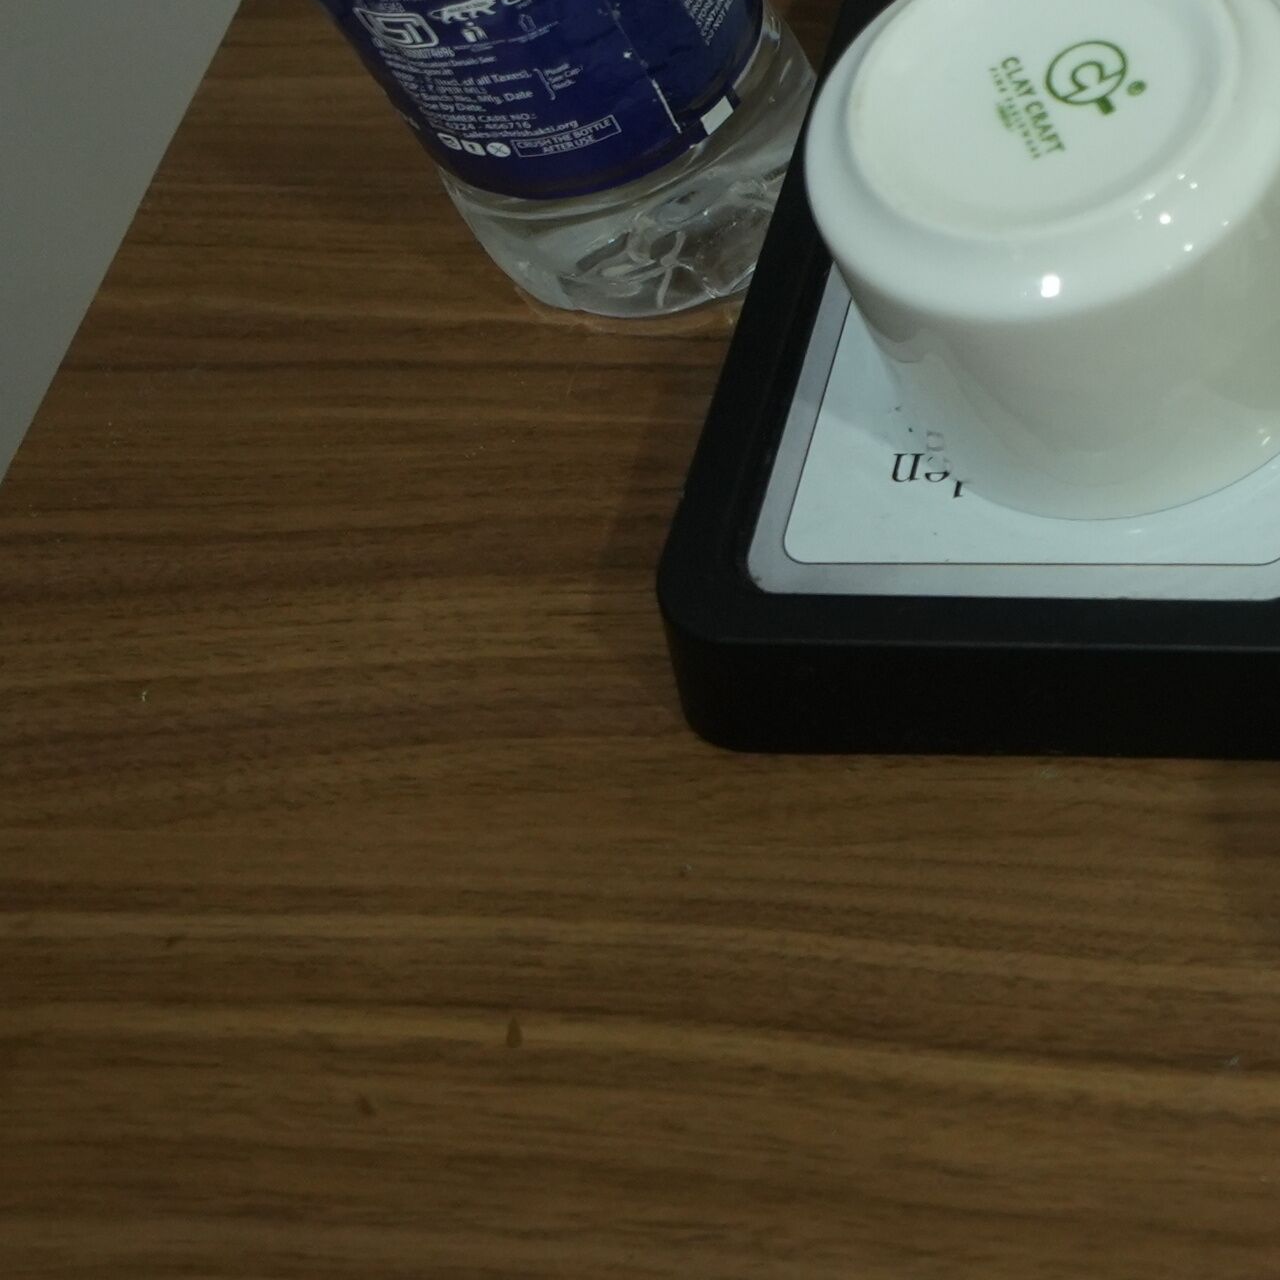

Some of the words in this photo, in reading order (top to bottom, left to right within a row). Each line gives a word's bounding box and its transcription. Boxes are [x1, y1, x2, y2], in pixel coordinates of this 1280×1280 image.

[552, 132, 573, 145] THE
[573, 118, 613, 139] BOTTLE
[1002, 56, 1036, 97] CLAY
[1025, 102, 1066, 153] CRAFT
